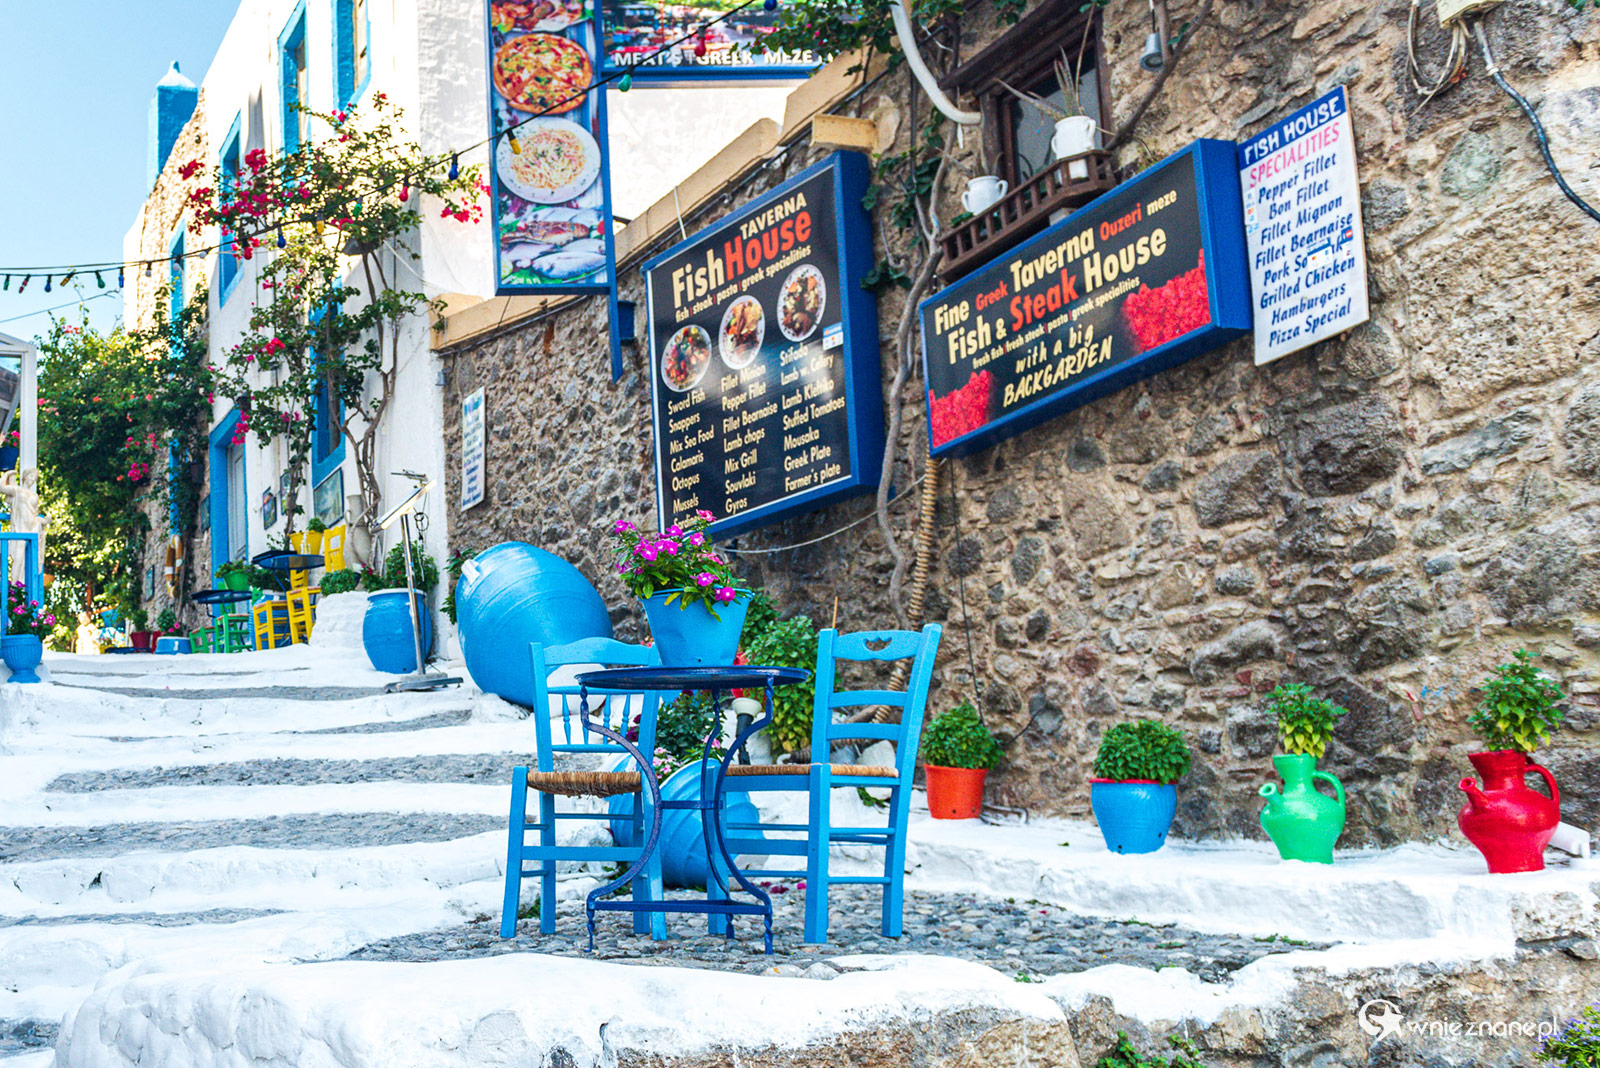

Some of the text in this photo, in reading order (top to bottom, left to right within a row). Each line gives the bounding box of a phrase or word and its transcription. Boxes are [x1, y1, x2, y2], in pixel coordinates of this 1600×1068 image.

[697, 50, 752, 65] GREEK
[765, 50, 812, 64] MEZE
[1245, 96, 1341, 164] FISH HOUSE
[1250, 122, 1340, 188] SPECIALITIES
[1259, 153, 1336, 204] Pepper Fillet
[1269, 200, 1291, 220] Bon
[1296, 178, 1329, 206] Fillet
[740, 192, 807, 240] TAVERNA
[1261, 194, 1342, 245] Fillet Mignon
[1256, 242, 1292, 270] Fillet
[1291, 211, 1353, 250] Bearnaise
[765, 245, 811, 277] specialities
[934, 189, 1176, 335] Fine Greek Taverna Ouzeri meze
[1260, 255, 1355, 310] Grilled Chicken
[1264, 266, 1289, 287] Pork
[949, 228, 1166, 364] Fish & Steak House
[1095, 277, 1140, 306] specialities
[1272, 281, 1346, 325] Hamburgers
[1269, 298, 1351, 347] Pizza Special
[1016, 324, 1094, 374] with a big
[721, 374, 738, 392] Fillet
[781, 366, 799, 386] Lamb
[1003, 335, 1112, 408] BACKGARDEN
[668, 389, 705, 415] Sword Fish
[722, 382, 766, 411] Pepper Fillet
[782, 390, 802, 410] Lamb
[669, 412, 700, 434] Snappers
[723, 401, 777, 434] Fillet Bearnaise
[783, 395, 845, 431] Stuffed Tomatoes
[670, 425, 714, 455] Mix Sea Food
[723, 426, 765, 453] Lamb chops
[784, 427, 819, 451] Mousaka
[671, 451, 704, 473] Calamaris
[725, 449, 757, 474] Mix Grill
[784, 445, 831, 472] Greek Plate
[672, 473, 700, 492] Octopus
[725, 472, 756, 495] Souvlaki
[820, 463, 840, 484] plate
[673, 494, 699, 513] Mussels
[725, 496, 747, 515] Gyros
